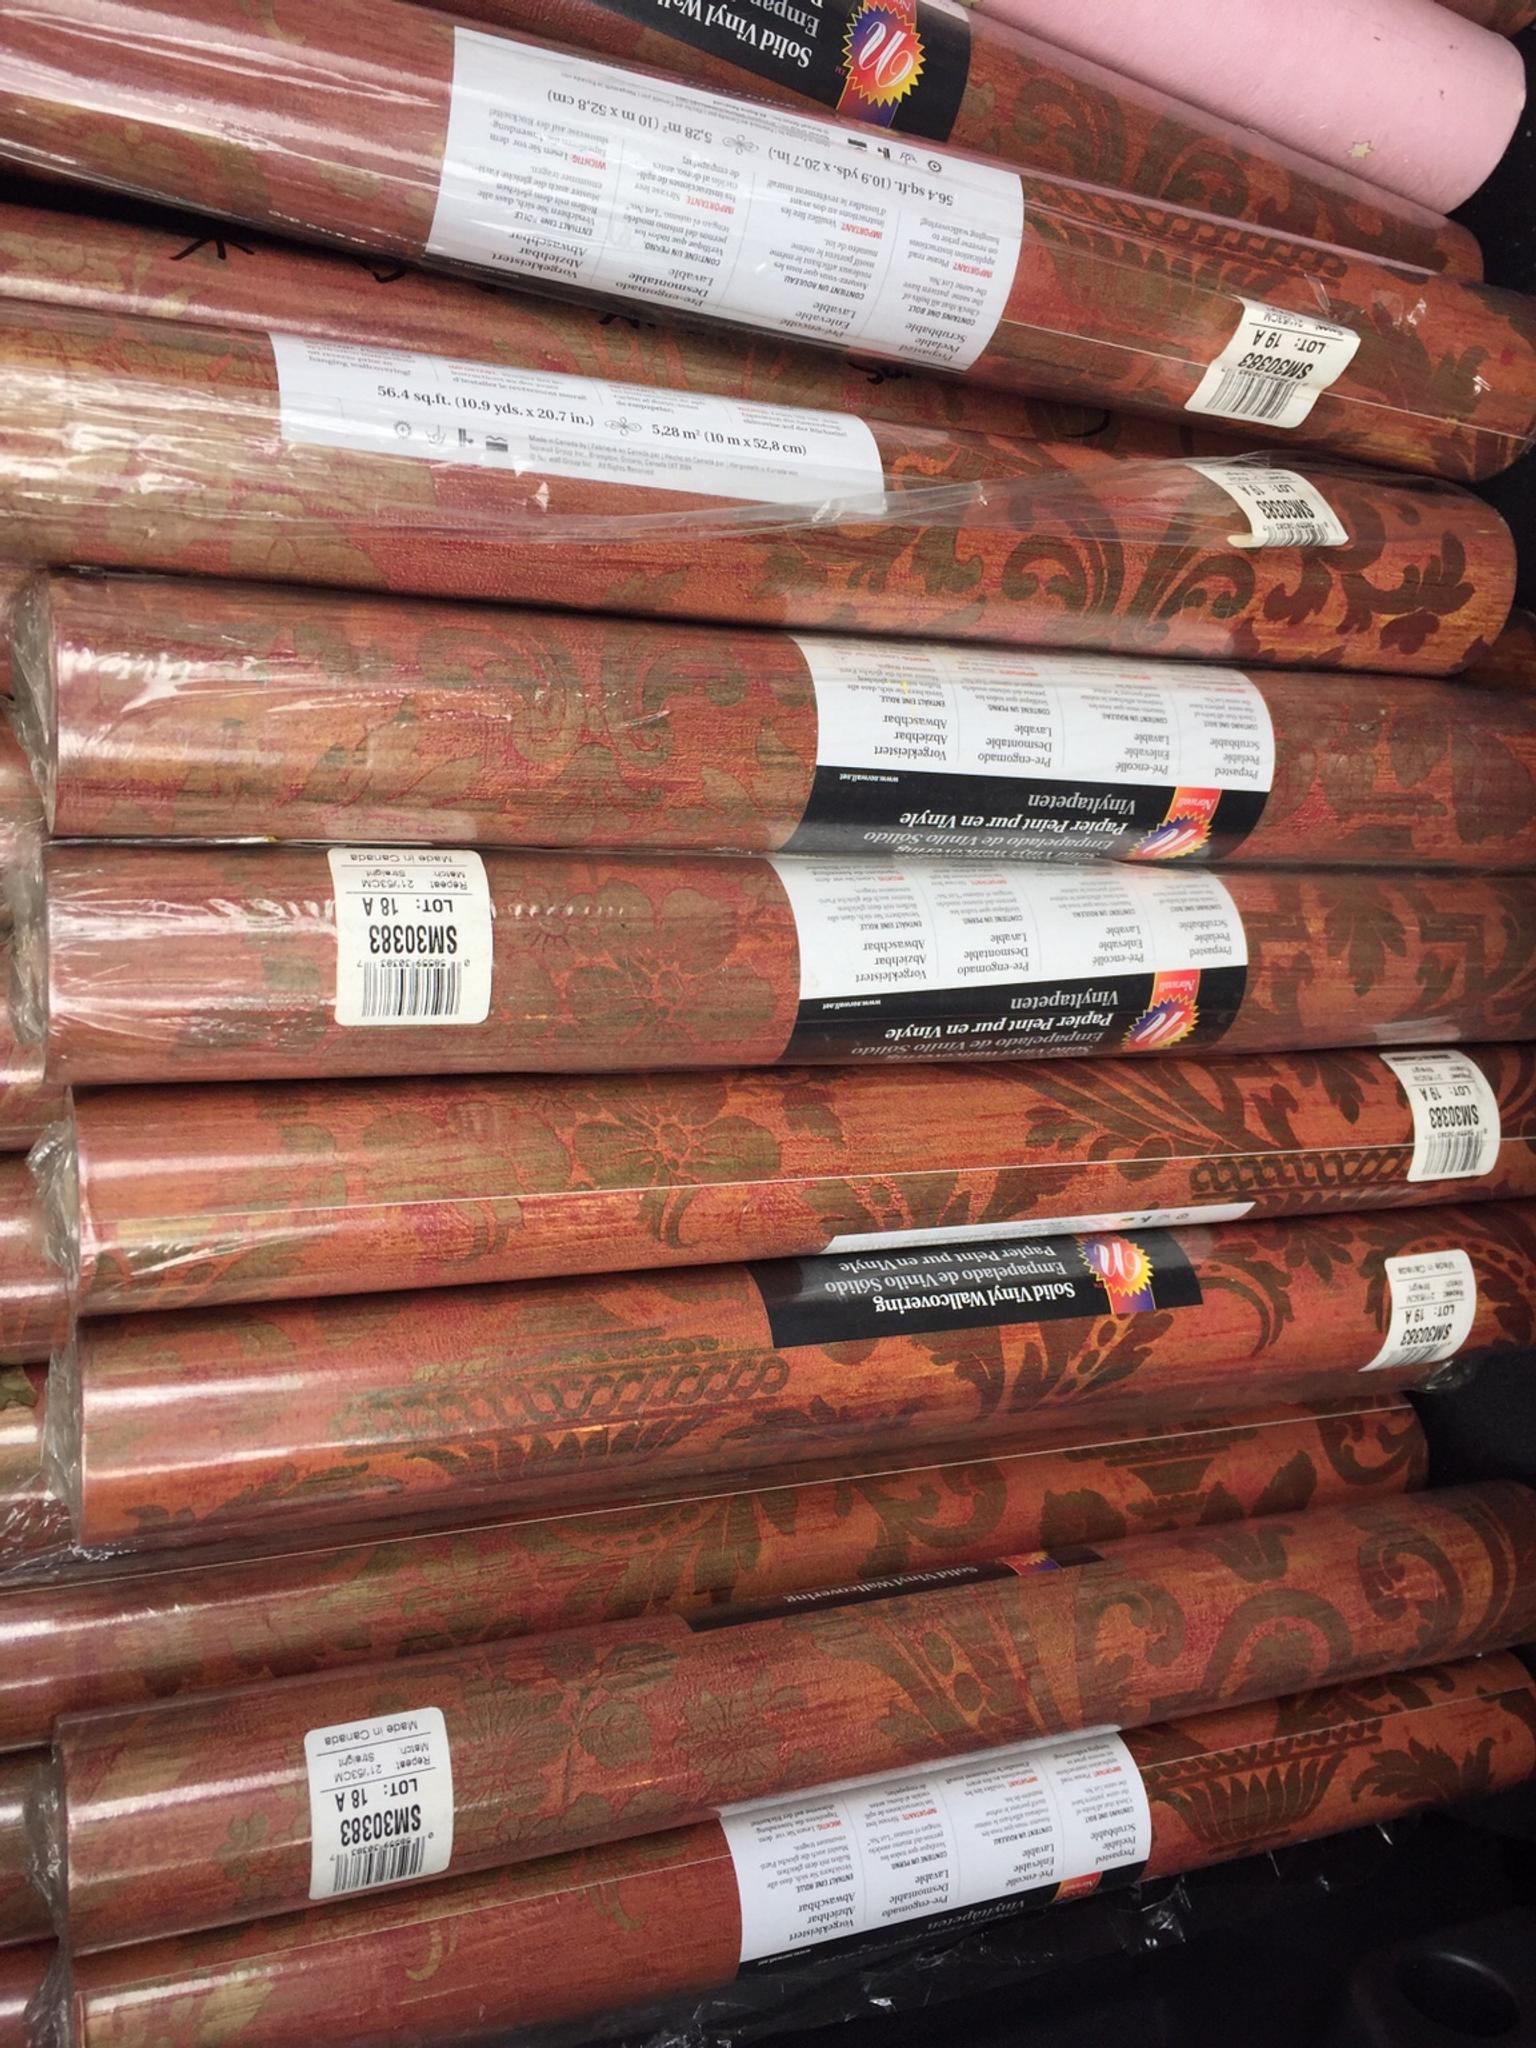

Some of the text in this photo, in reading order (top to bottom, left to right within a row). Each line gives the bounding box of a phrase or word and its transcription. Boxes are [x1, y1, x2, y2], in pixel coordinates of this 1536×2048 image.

[700, 10, 757, 47] Vinyl
[758, 34, 812, 68] Solid
[545, 88, 576, 107] cm)
[576, 96, 608, 115] 52,8
[607, 106, 618, 115] x
[620, 109, 635, 120] m
[636, 111, 660, 129] (10
[683, 123, 713, 143] 5,28
[766, 145, 791, 163] in.)
[793, 154, 821, 171] 20.7
[821, 161, 831, 170] x
[831, 162, 859, 180] yds.
[859, 169, 892, 189] (10.9
[926, 189, 954, 205] 56.4
[507, 231, 588, 257] Abwaschbar
[489, 250, 578, 279] Vorgekleistert
[517, 246, 583, 269] Abziehbar
[627, 271, 708, 298] Desmontable
[666, 268, 714, 286] Lavable
[811, 301, 855, 318] Lavable
[904, 321, 967, 343] Scrubbable
[1252, 329, 1325, 354] LOT: 19 A
[1237, 352, 1314, 380] SM30383
[377, 385, 410, 399] 56.4
[454, 396, 491, 413] (10.9
[493, 402, 524, 418] yds.
[525, 409, 534, 417] x
[537, 408, 566, 422] 20.7
[568, 413, 595, 428] in.)
[650, 424, 680, 439] 5,28
[703, 431, 725, 446] (10
[726, 437, 741, 446] m
[752, 439, 779, 454] 52,8
[780, 443, 807, 458] cm)
[1256, 500, 1313, 519] SM30383
[882, 714, 947, 729] Abwaschbar
[1013, 724, 1052, 736] Lavable
[893, 731, 948, 745] Abziehbar
[985, 737, 1052, 751] Desmontable
[1133, 733, 1169, 745] Lavable
[1209, 738, 1260, 750] Scrubbable
[873, 743, 946, 760] Vorgekleistert
[976, 750, 1052, 767] Pre-engomado
[1123, 747, 1169, 759] Enlevable
[1222, 753, 1259, 764] Peelable
[1214, 766, 1257, 779] Prepasted
[1027, 790, 1136, 814] Vinyltapeten
[899, 809, 1127, 834] Papier Peint pur en Vinyle
[863, 831, 1113, 850] Empapelado de Vinilo Sólido
[349, 854, 452, 862] Made in Canada
[362, 897, 452, 915] LOT: 18 A
[368, 925, 457, 953] SM30383
[990, 932, 1026, 944] Lavable
[1105, 925, 1139, 936] Lavable
[862, 939, 925, 951] Abwaschbar
[963, 947, 1028, 960] Desmontable
[1098, 939, 1142, 950] Enlevable
[873, 954, 926, 966] Abziehbar
[956, 960, 1028, 975] Pre-engomado
[854, 967, 926, 983] Vorgekleistert
[1010, 987, 1118, 1009] Vinyltapeten
[884, 1010, 1113, 1040] Papier Peint pur en Vinyle
[914, 1040, 965, 1051] Vinilo
[969, 1039, 992, 1048] de
[994, 1030, 1103, 1047] Empapelado
[850, 1043, 910, 1054] Sólido
[1418, 1087, 1427, 1101] A
[1447, 1085, 1470, 1095] LOT:
[1428, 1104, 1478, 1128] SM30383
[837, 1243, 1056, 1273] Papier Peint pur en Vinyle
[824, 1257, 1067, 1296] Empapelado de Vinilo Sólido
[871, 1282, 1075, 1316] Solid Vinyl Wallcovering
[1404, 1304, 1454, 1324] LOT: 19 A
[1398, 1323, 1453, 1345] SM30383
[324, 1719, 418, 1746] Made in Canada
[337, 1750, 375, 1767] Straight
[334, 1777, 418, 1812] LOT: 18 A
[341, 1804, 422, 1846] SM30383
[1089, 1823, 1136, 1841] Scrubbable
[1021, 1843, 1054, 1858] Lavable
[1102, 1835, 1136, 1850] Peelable
[1012, 1856, 1054, 1873] Enlevable
[1094, 1847, 1135, 1864] Prepasted
[914, 1869, 949, 1885] Lavable
[888, 1882, 949, 1904] Desmontable
[796, 1892, 855, 1913] Abwaschbar
[880, 1893, 948, 1918] Pre-engomado
[805, 1905, 855, 1925] Abziehbar
[787, 1917, 854, 1941] Vorgekleistert
